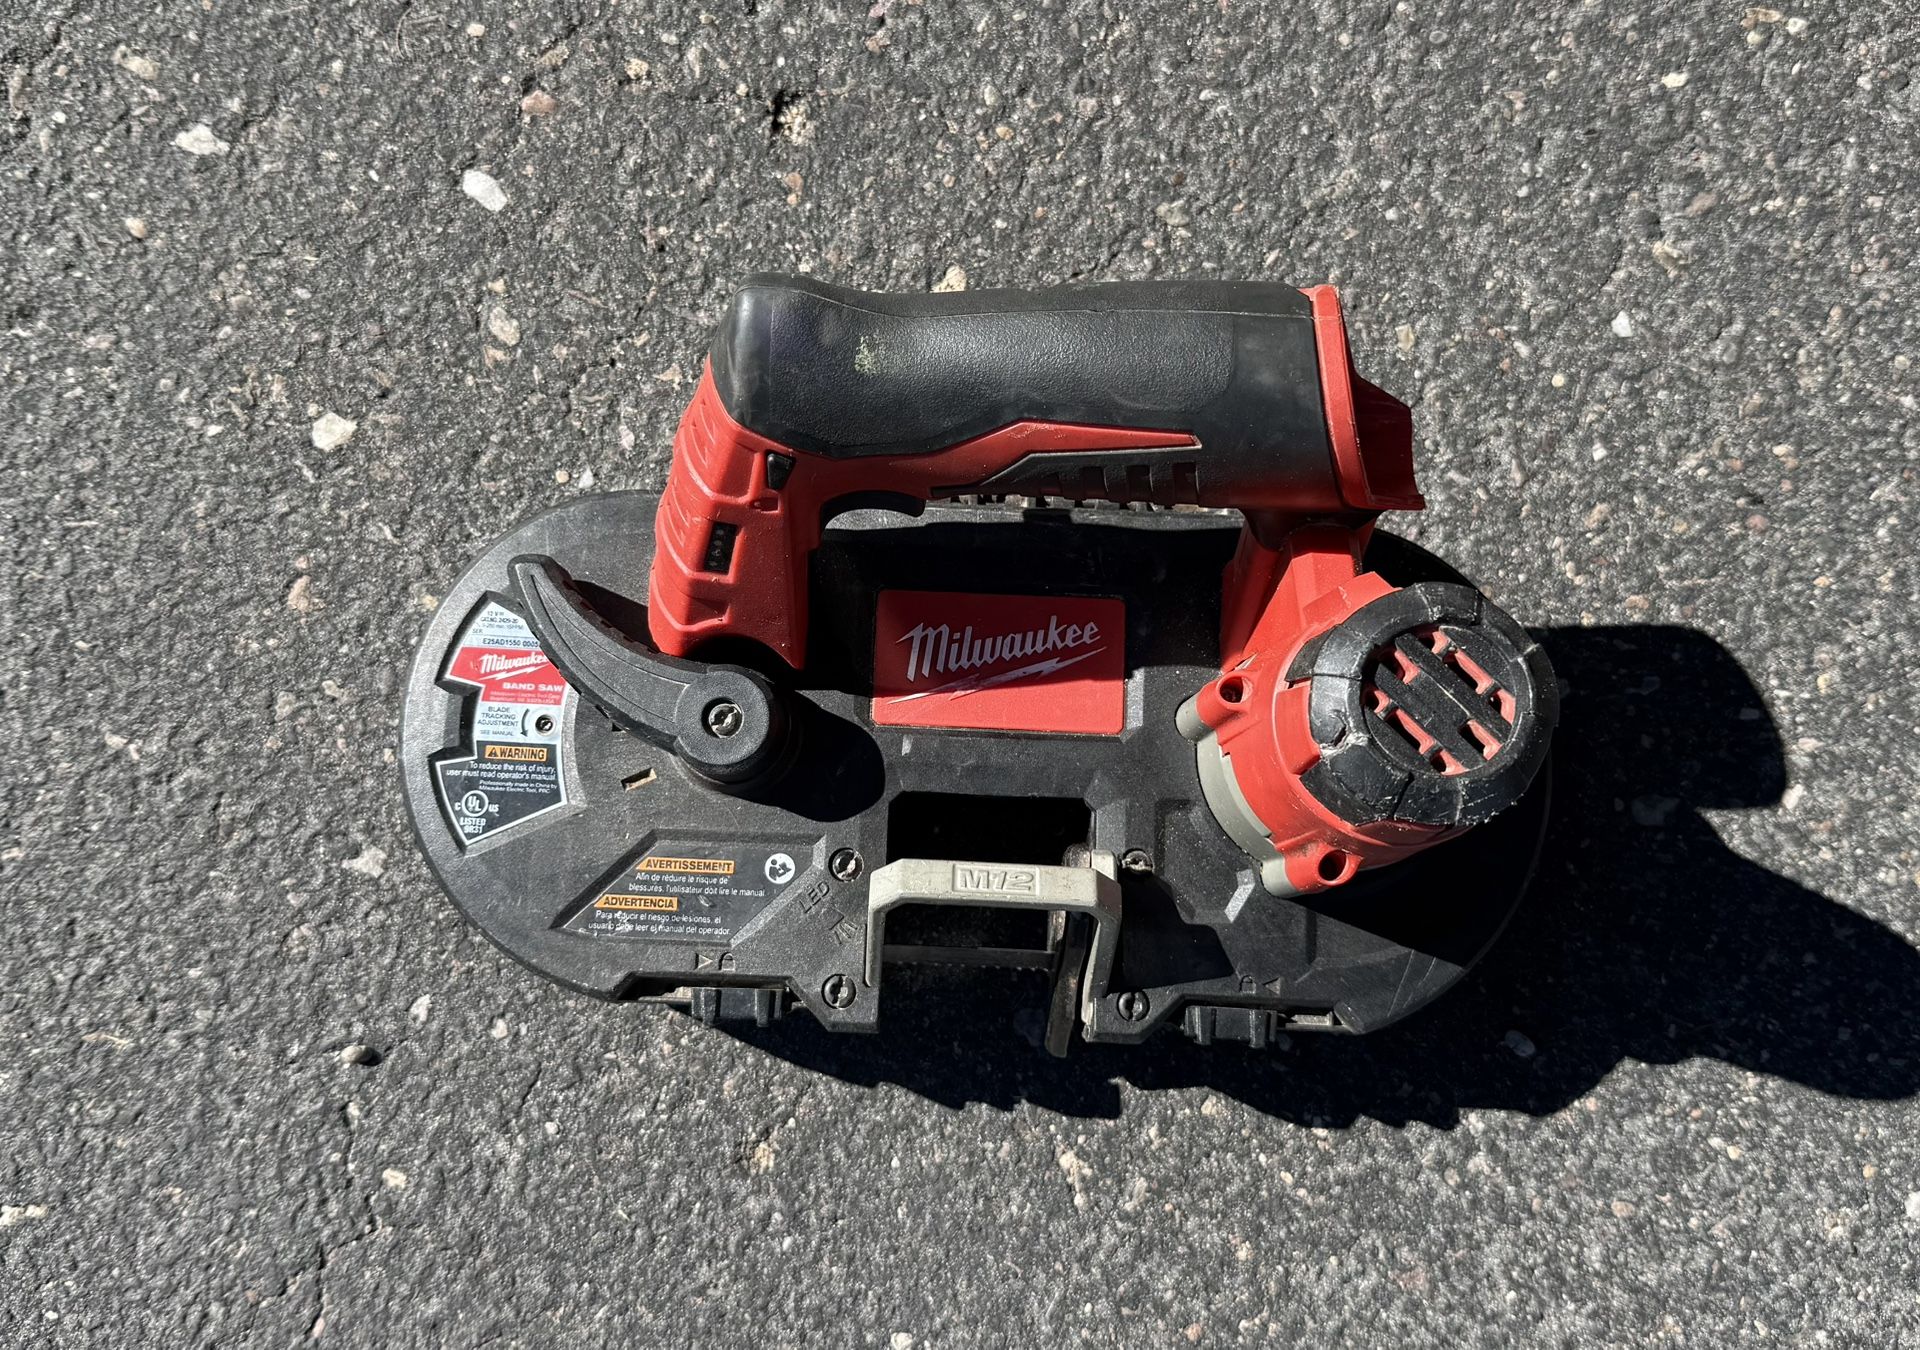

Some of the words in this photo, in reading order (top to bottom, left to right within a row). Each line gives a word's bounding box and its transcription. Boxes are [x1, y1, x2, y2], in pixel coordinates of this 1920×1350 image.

[895, 615, 1101, 683] Milwaukee
[502, 682, 535, 690] BAND
[538, 684, 564, 692] SAW
[481, 712, 516, 720] TRACKING
[477, 719, 519, 727] ADJUSTMENT
[500, 747, 545, 760] WARNING
[470, 761, 478, 769] To
[479, 762, 501, 771] reduce
[446, 769, 461, 777] user
[462, 769, 479, 777] must
[497, 772, 529, 780] operator's
[460, 817, 486, 826] LISTED
[645, 858, 732, 872] AVERTISSEMENT
[695, 876, 718, 885] risque
[958, 868, 1035, 892] M12
[704, 887, 718, 895] doit
[718, 887, 730, 896] lire
[731, 888, 738, 896] le
[603, 896, 674, 909] ADVERTENCIA
[799, 881, 831, 914] LED
[595, 910, 612, 919] Para
[647, 914, 669, 923] riesgo
[714, 916, 722, 924] el
[635, 923, 649, 931] leer
[658, 924, 685, 933] manual
[685, 926, 698, 934] del
